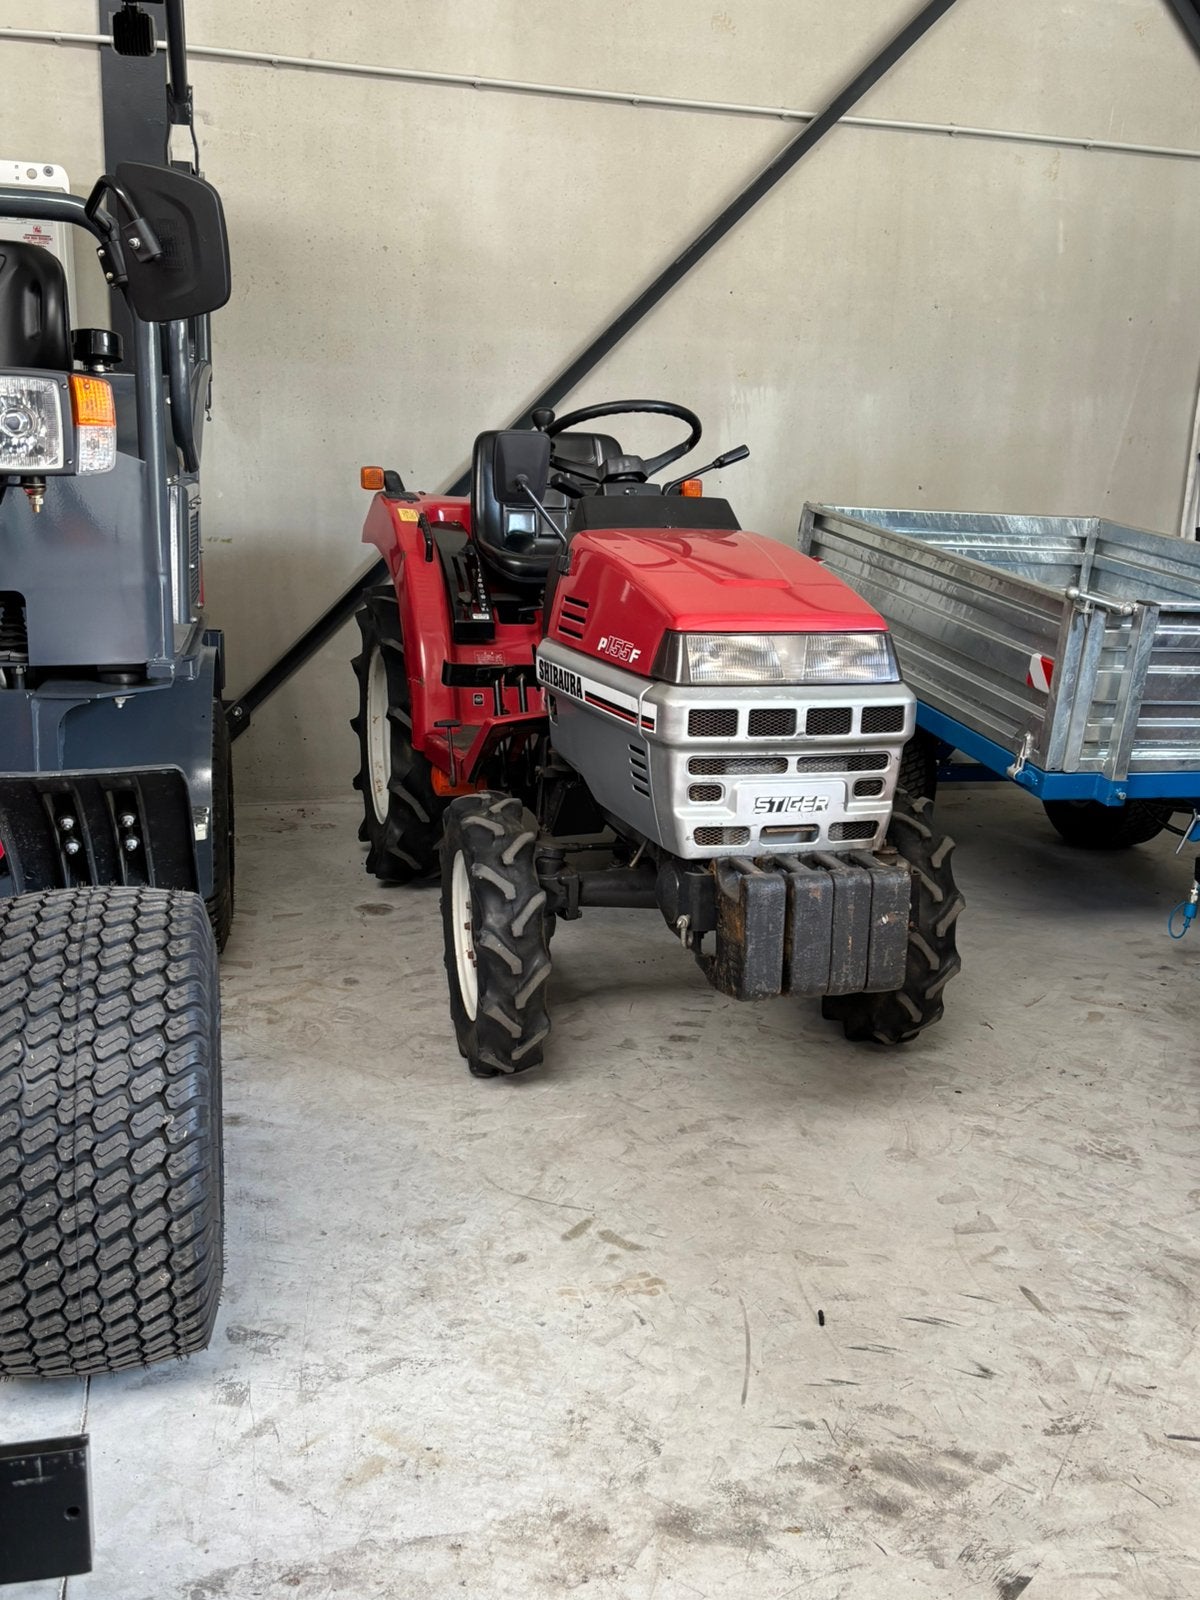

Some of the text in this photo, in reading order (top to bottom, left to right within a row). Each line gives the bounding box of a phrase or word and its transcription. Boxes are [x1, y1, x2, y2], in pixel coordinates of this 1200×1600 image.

[597, 635, 641, 663] P155F
[539, 659, 583, 699] SHIBAURA
[753, 796, 829, 814] STIGER
